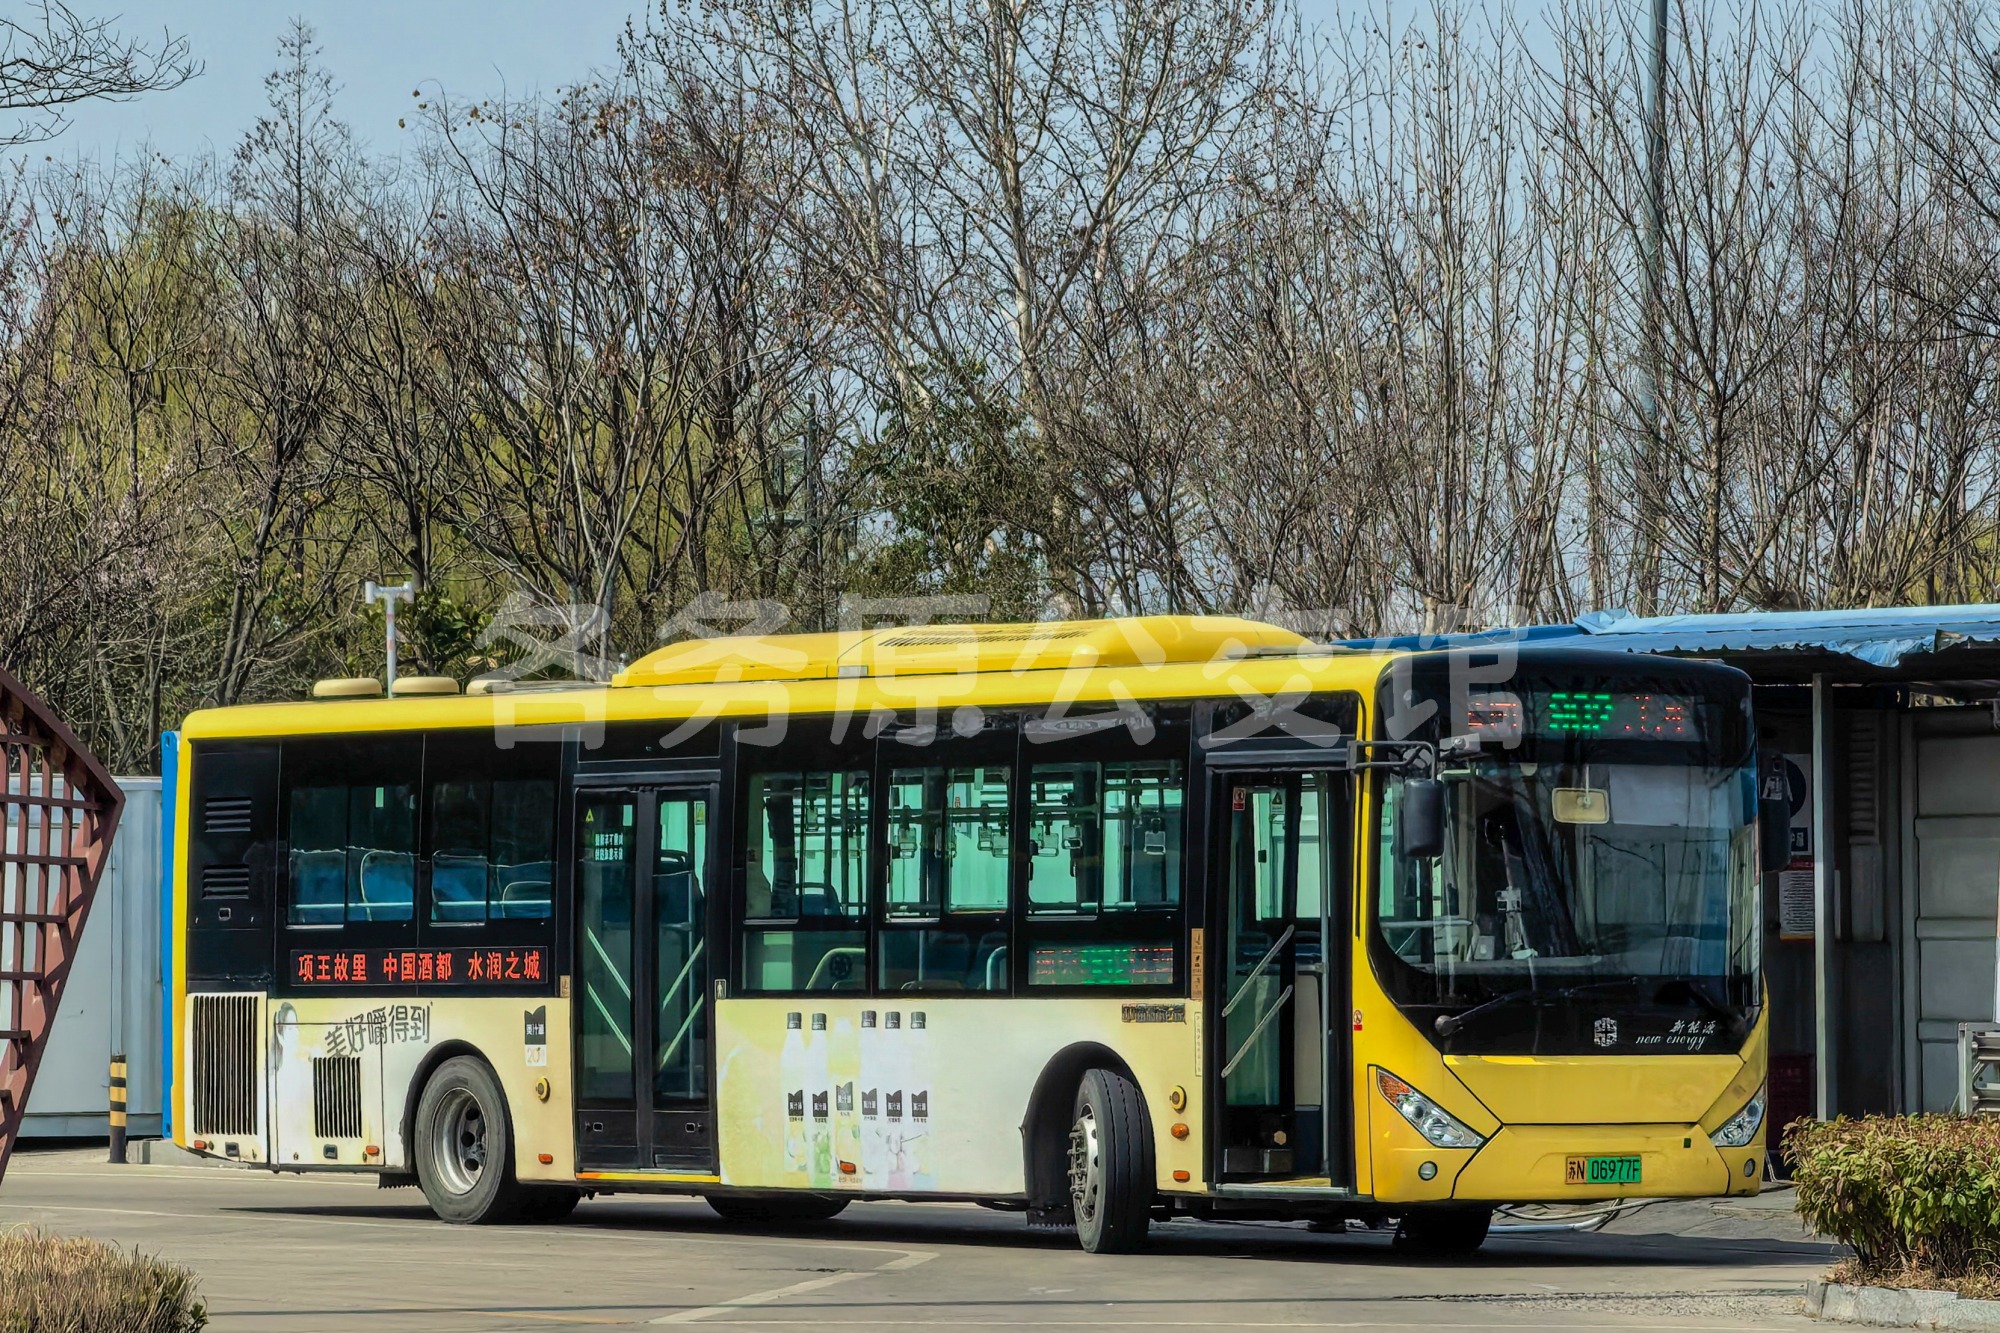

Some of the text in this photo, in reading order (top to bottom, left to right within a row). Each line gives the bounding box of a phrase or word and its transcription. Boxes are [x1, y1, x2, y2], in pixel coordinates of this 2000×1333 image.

[298, 951, 541, 982] 项王故里 中国酒都 水润之城
[1669, 1019, 1717, 1034] 新能源
